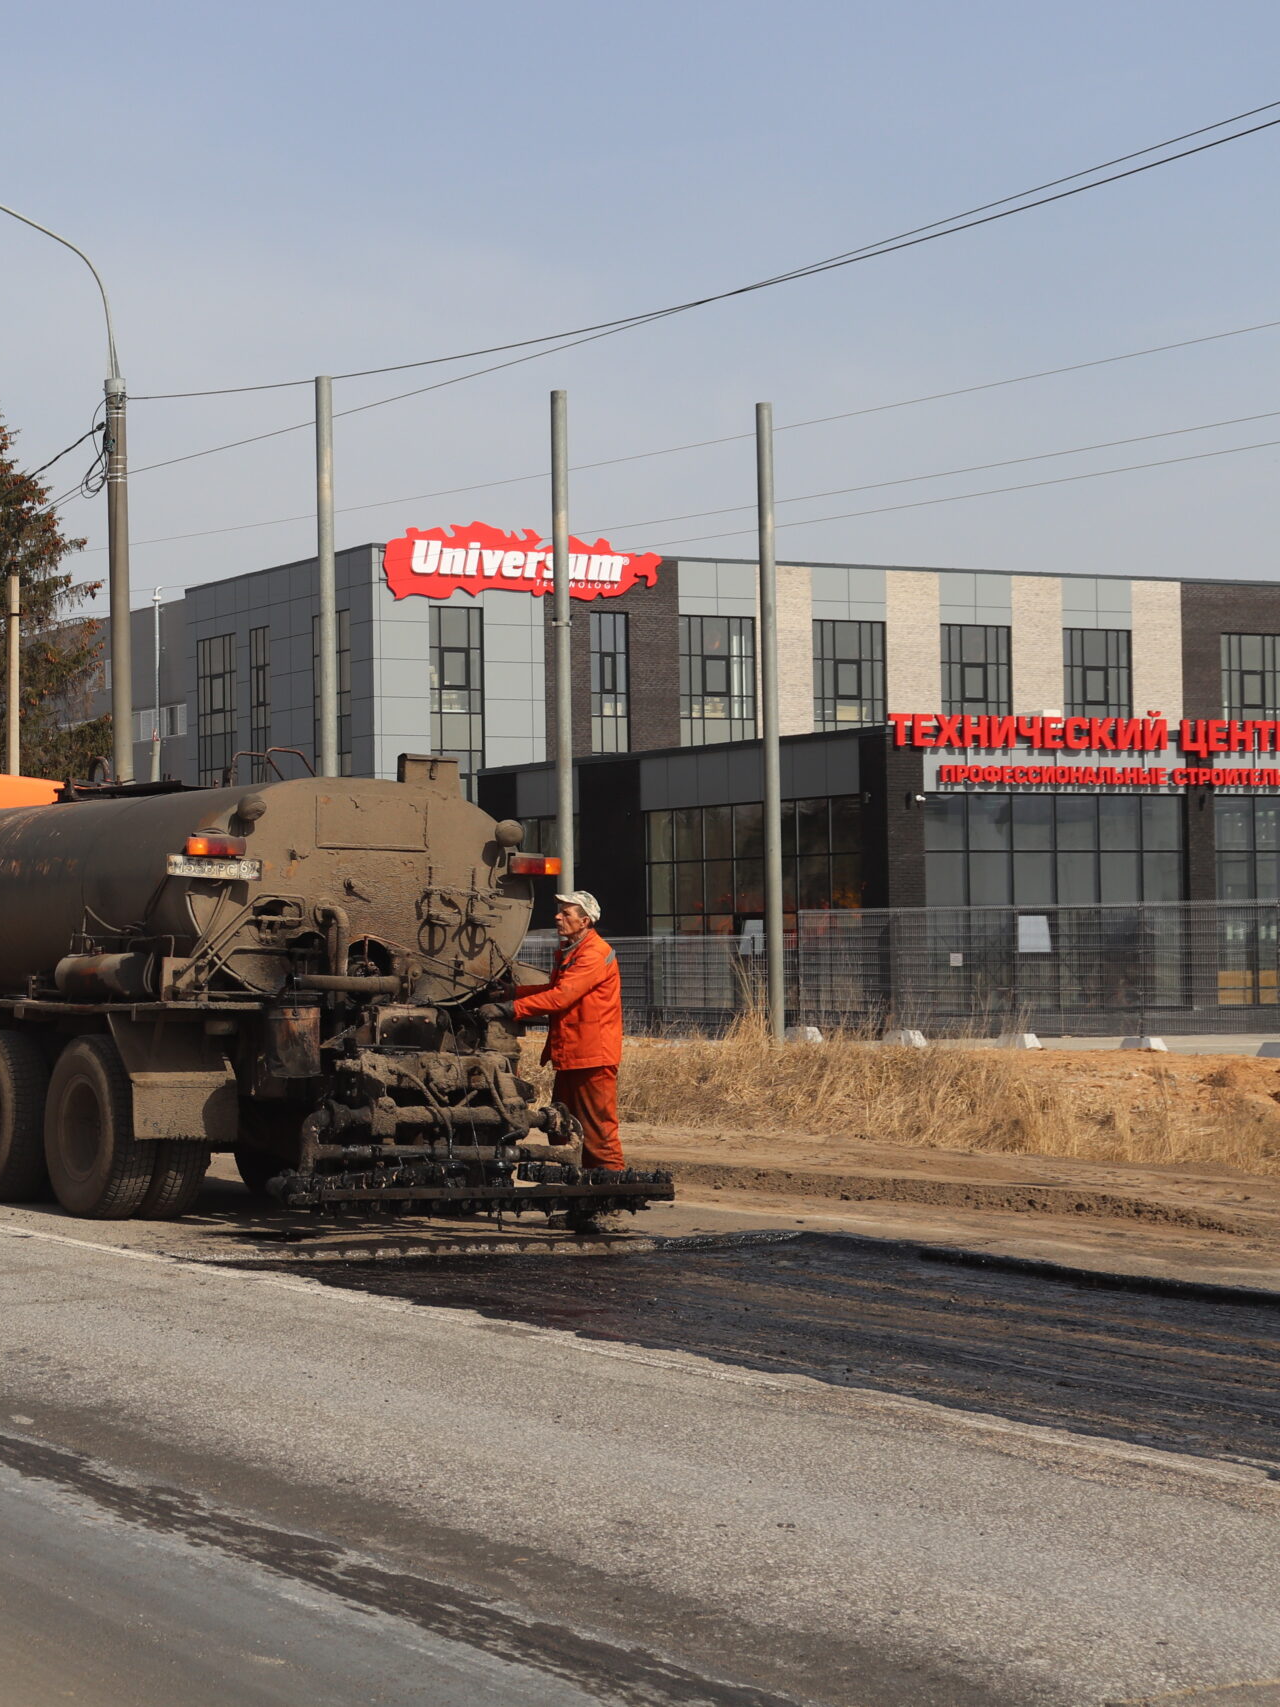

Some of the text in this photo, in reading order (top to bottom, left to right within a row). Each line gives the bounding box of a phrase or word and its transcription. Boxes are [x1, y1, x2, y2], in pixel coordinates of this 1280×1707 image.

[887, 710, 1280, 758] ТЕХНИЧЕСКИЙ ЦЕНТ
[939, 764, 1167, 785] ПРОФЕССИОНАЛЬНЫЕ
